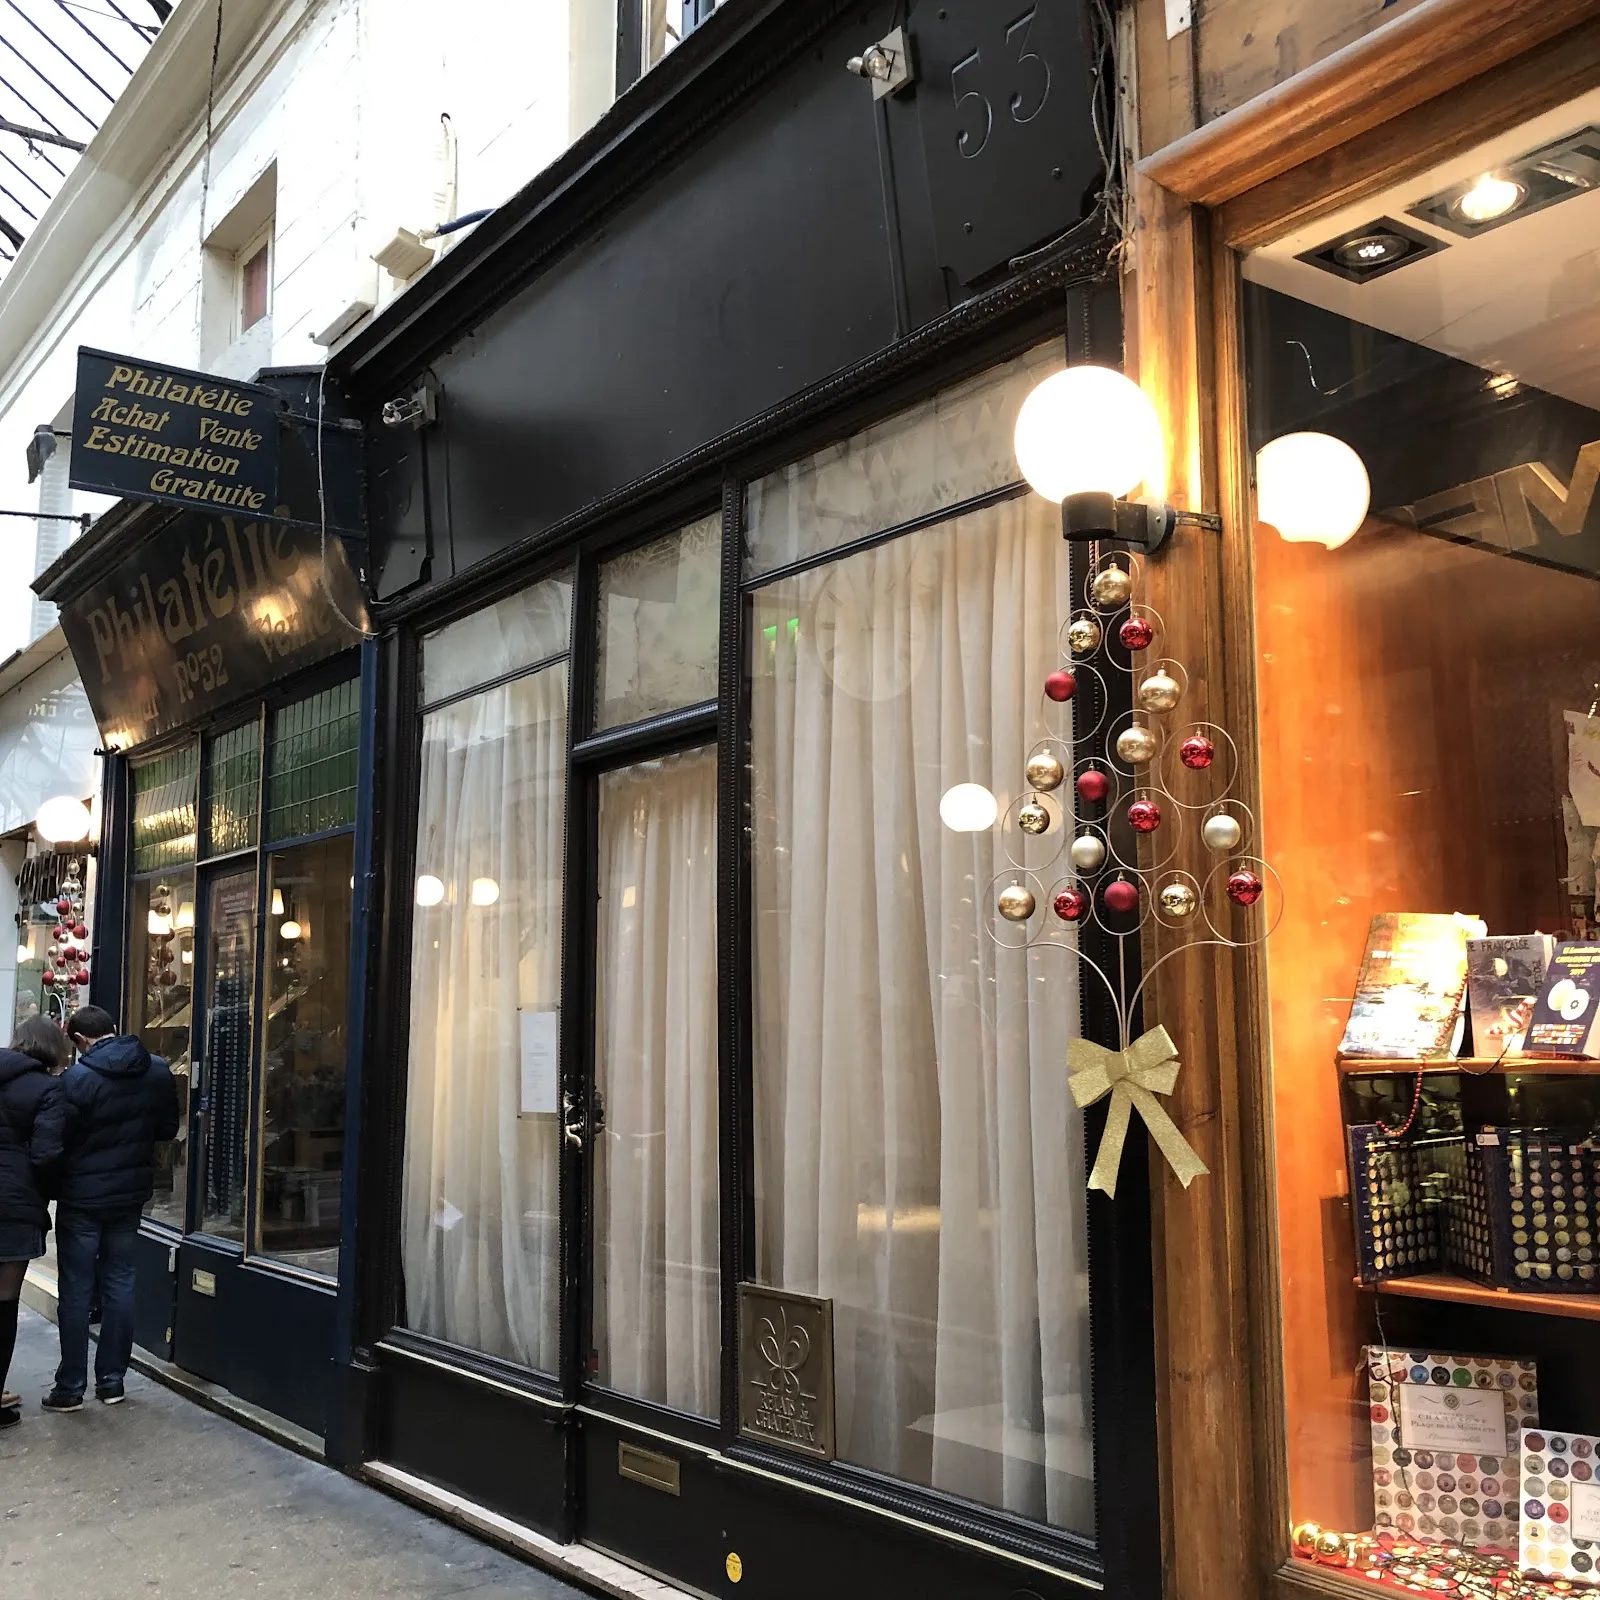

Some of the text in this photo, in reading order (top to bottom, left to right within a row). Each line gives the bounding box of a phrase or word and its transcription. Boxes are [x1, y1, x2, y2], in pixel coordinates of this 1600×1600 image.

[951, 2, 1051, 159] 53
[104, 365, 254, 417] Philatélie
[90, 396, 263, 451] Achat Vente
[83, 425, 241, 477] Estimation
[150, 468, 267, 510] Gratuite
[87, 505, 300, 686] Philatélie
